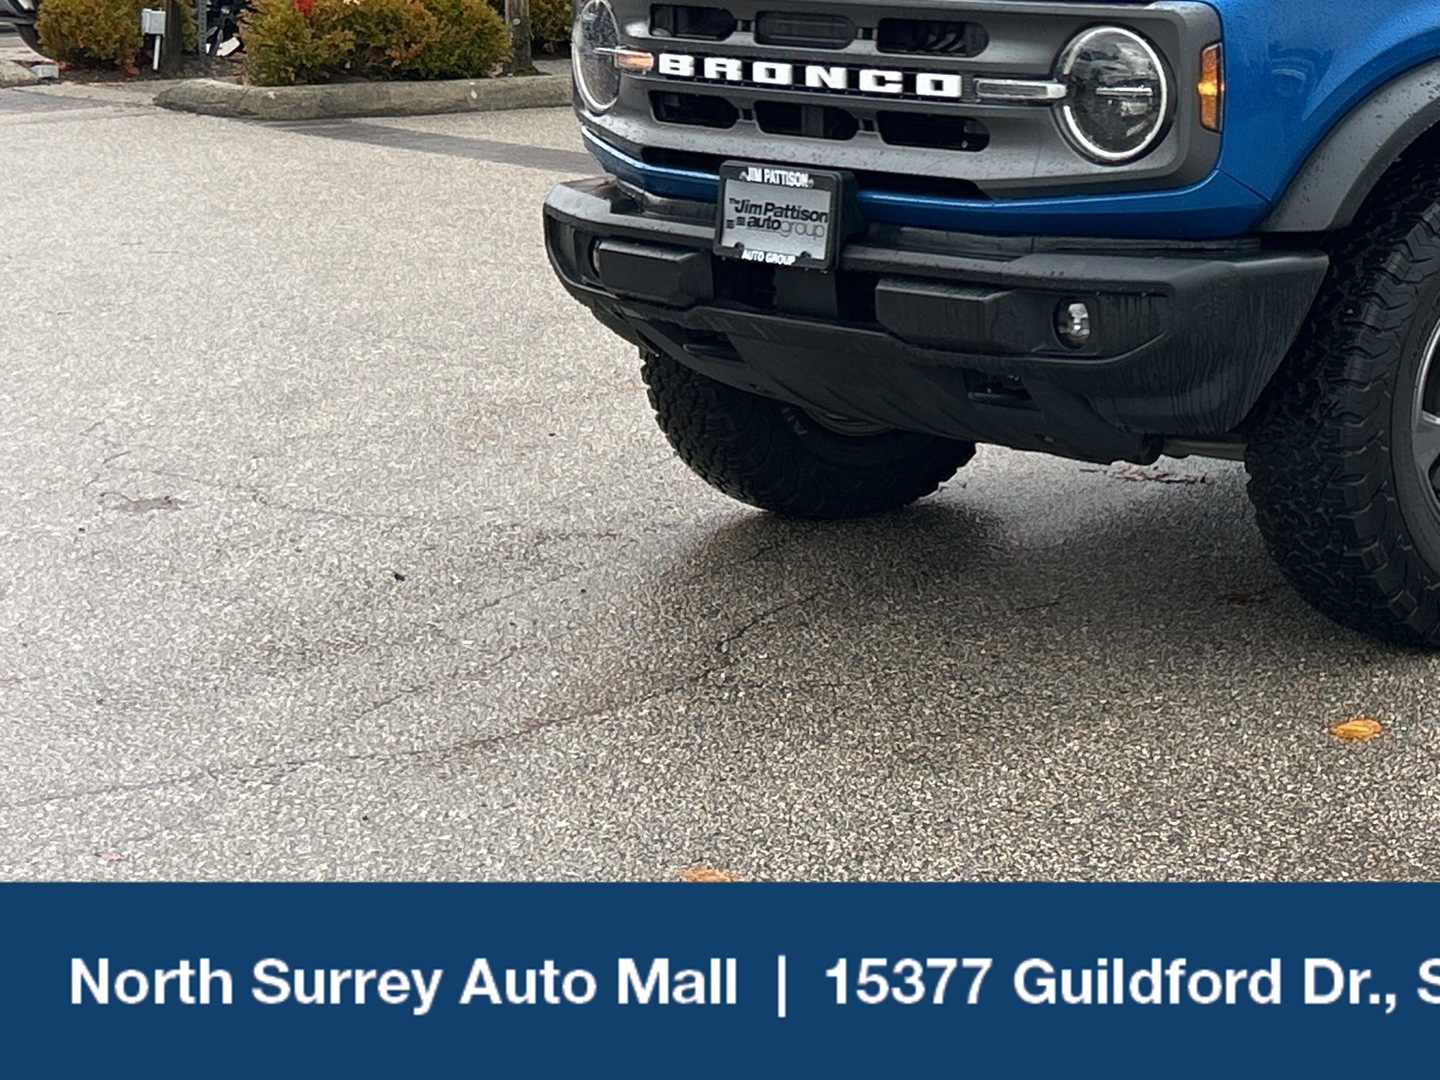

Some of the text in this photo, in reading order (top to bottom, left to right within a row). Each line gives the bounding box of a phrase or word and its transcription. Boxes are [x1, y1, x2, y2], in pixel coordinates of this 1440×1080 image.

[658, 53, 962, 98] BRONCO
[746, 167, 809, 188] JIM PATTISON
[741, 249, 796, 266] AUTO GROUP
